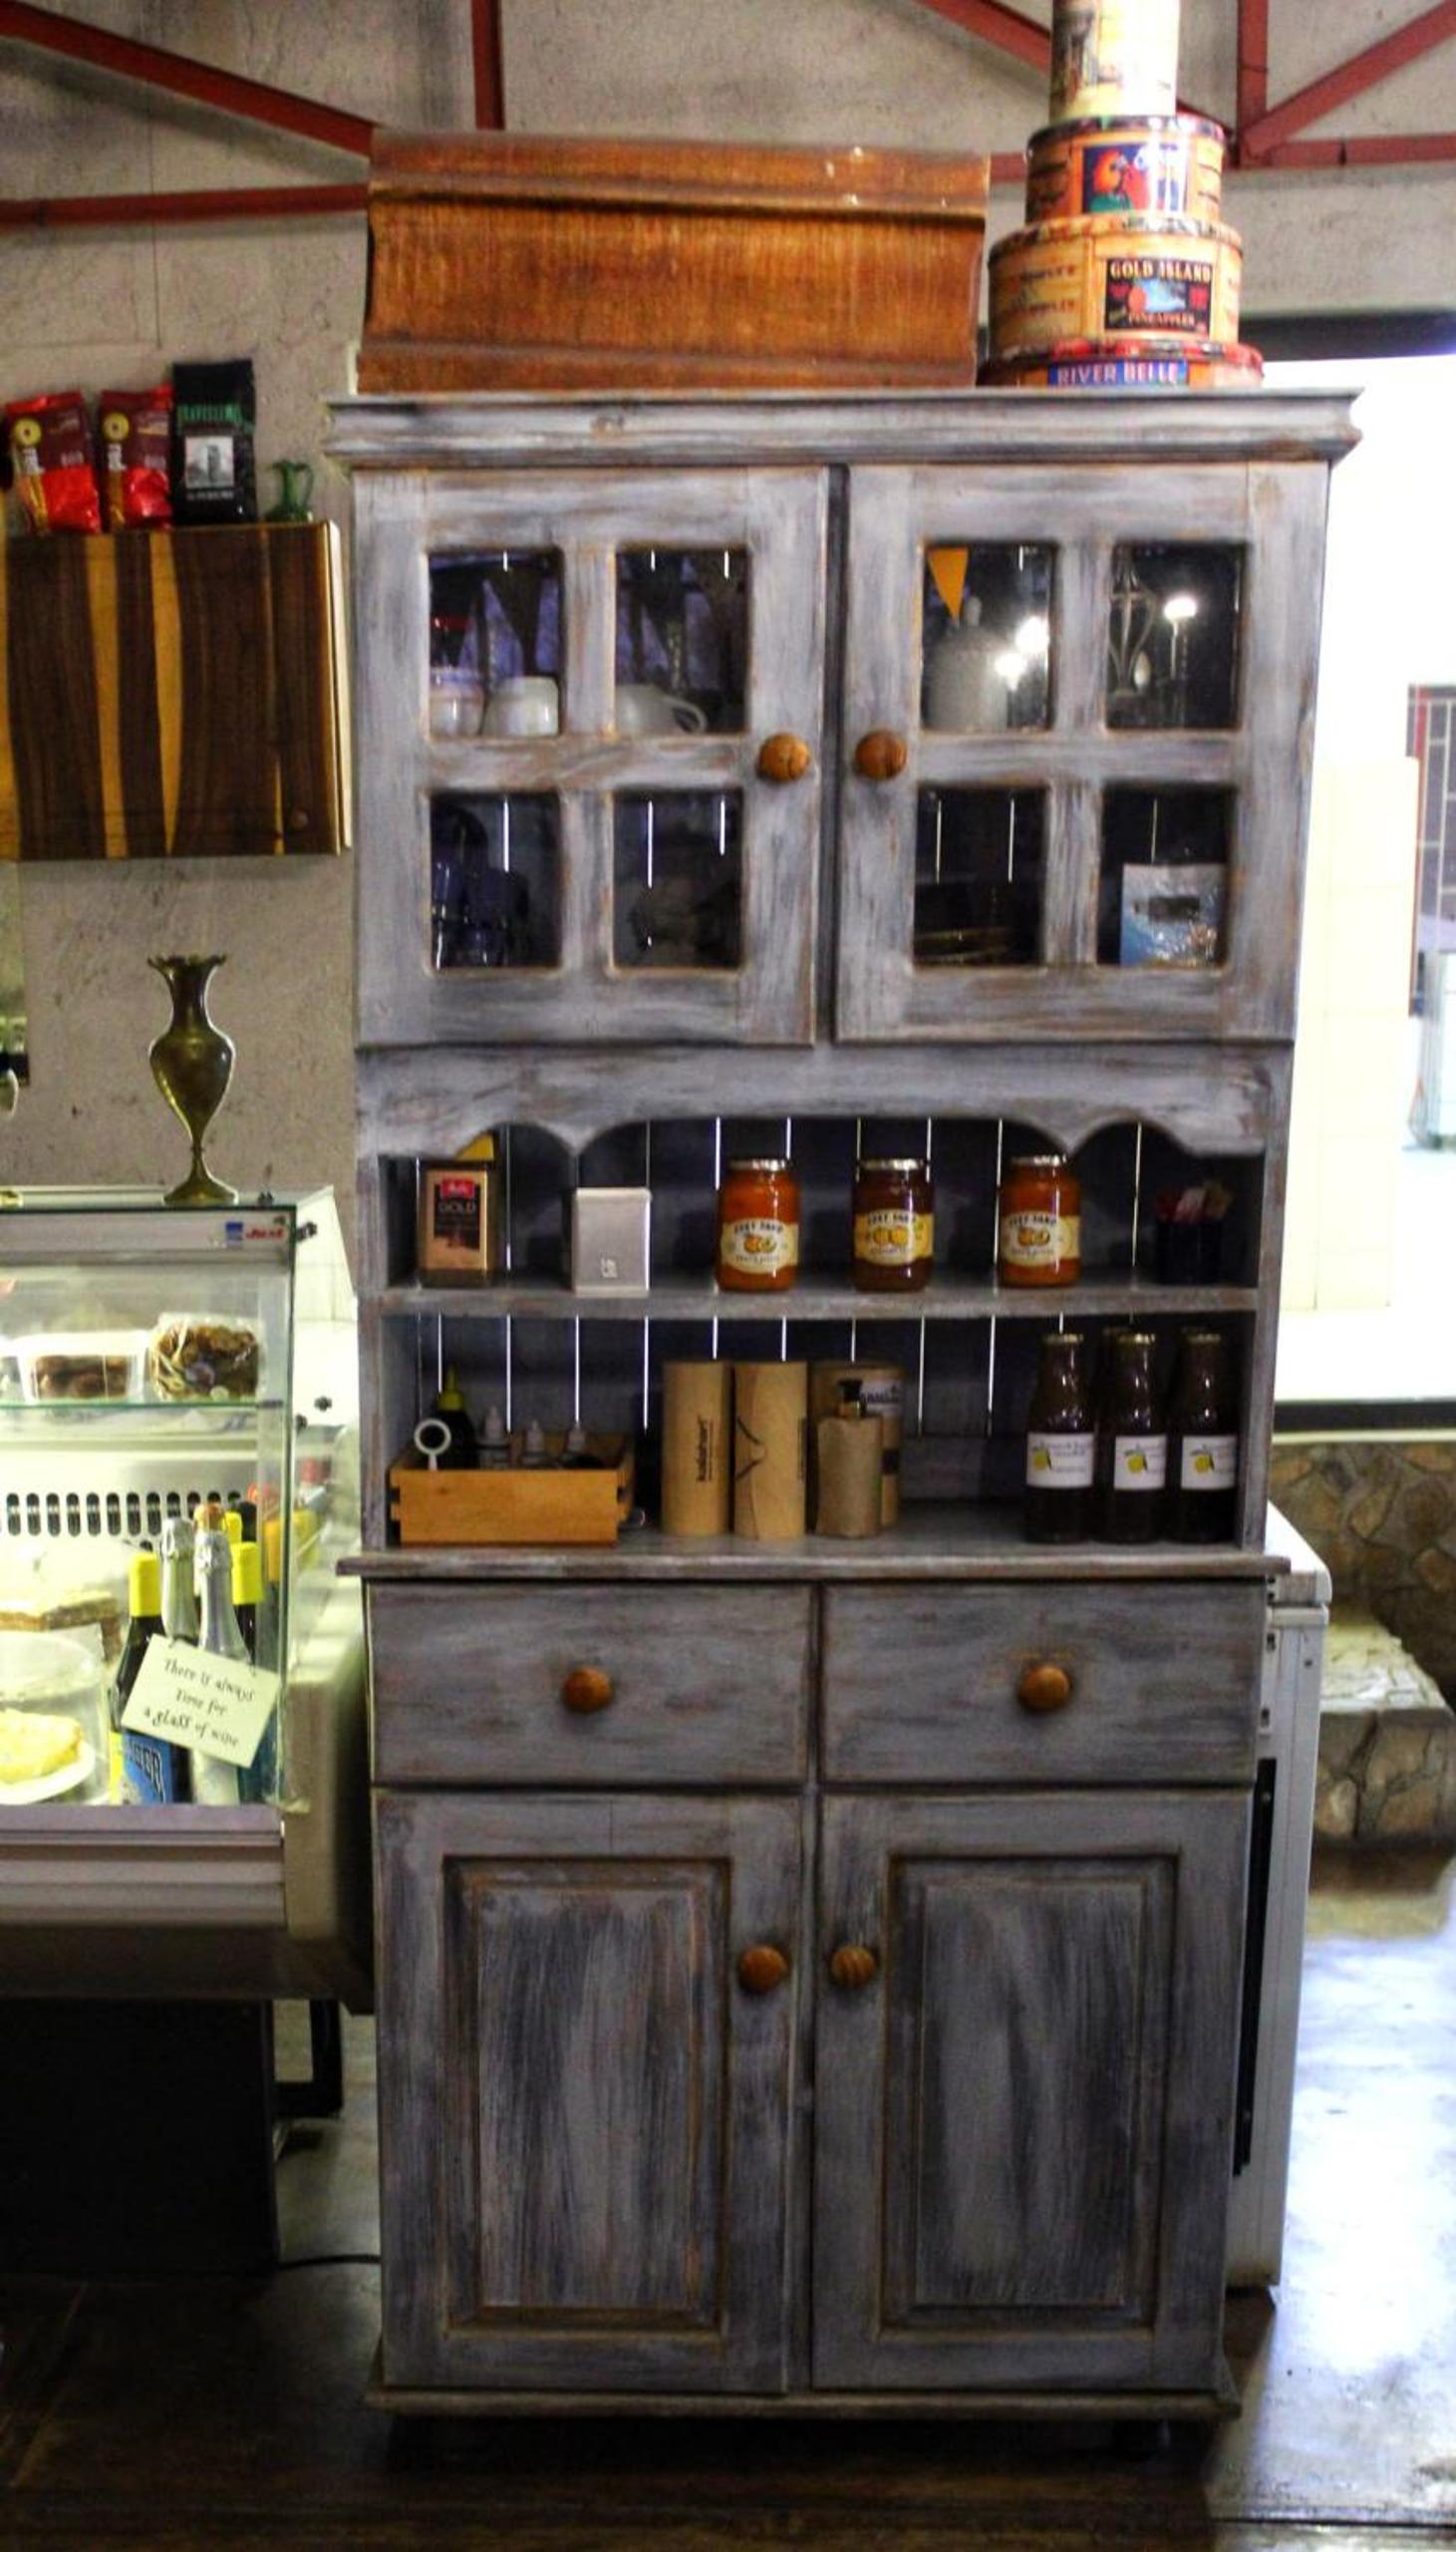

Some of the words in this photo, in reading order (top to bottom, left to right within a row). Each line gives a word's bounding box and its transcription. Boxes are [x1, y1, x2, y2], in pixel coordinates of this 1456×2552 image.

[1109, 259, 1154, 279] GOLD
[1158, 260, 1211, 284] ISLAND
[1057, 363, 1117, 385] RIVER
[1123, 360, 1178, 384] BELLE
[215, 1678, 255, 1701] always
